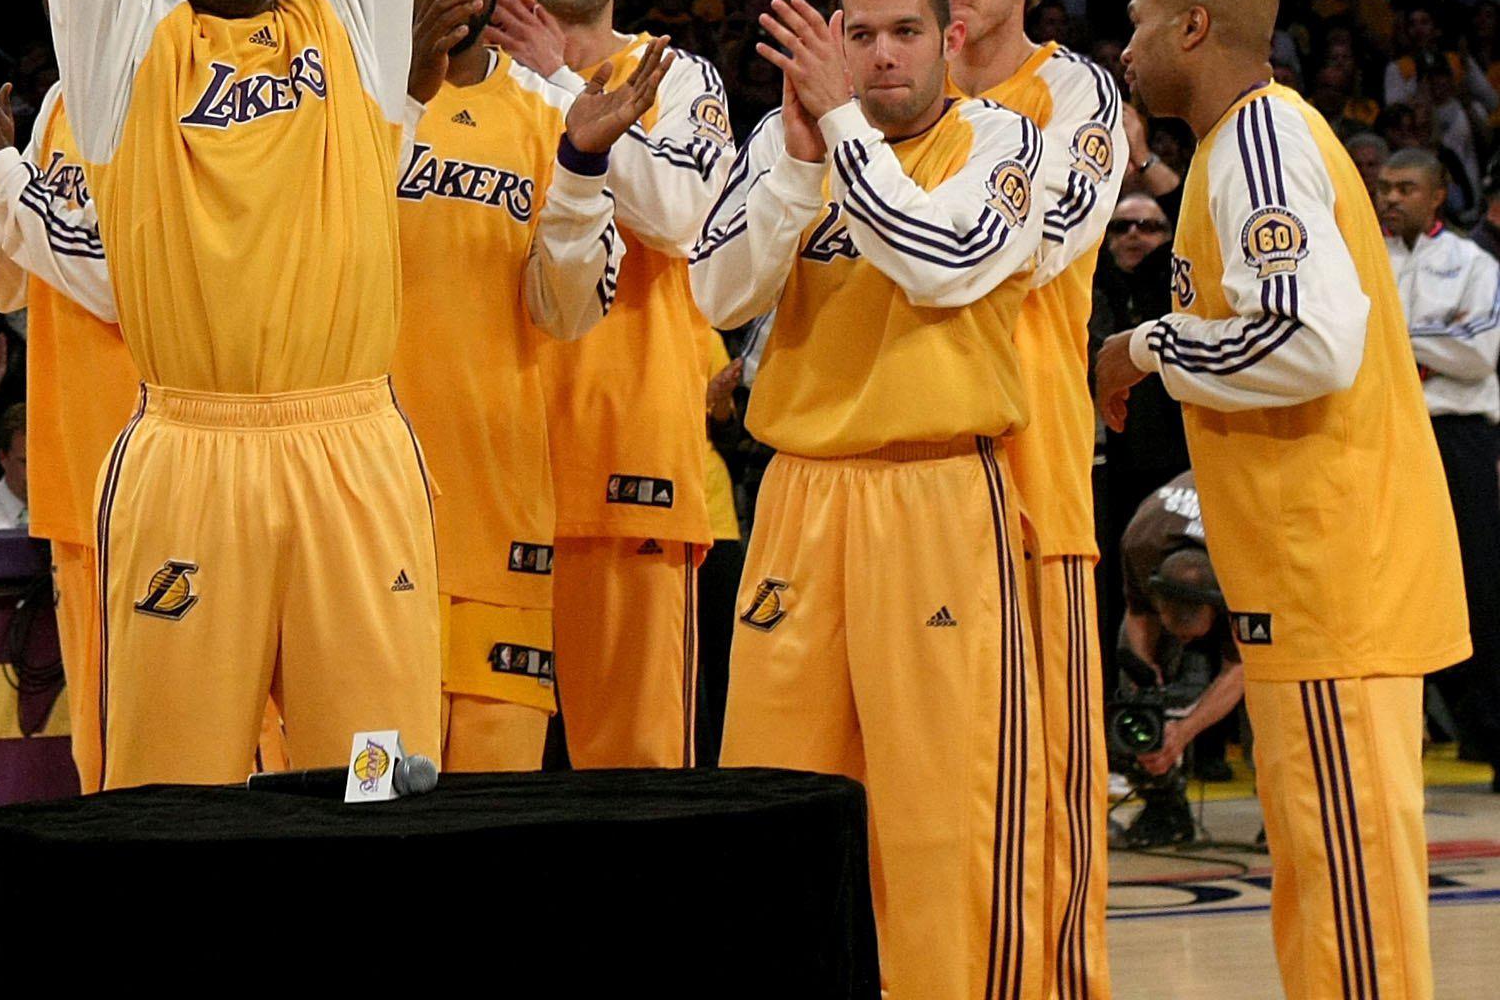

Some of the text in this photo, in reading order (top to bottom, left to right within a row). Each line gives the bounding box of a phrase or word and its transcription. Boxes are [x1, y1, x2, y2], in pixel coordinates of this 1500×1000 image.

[249, 35, 278, 48] adidas
[179, 48, 326, 128] LAKERS
[1084, 135, 1108, 167] 60
[396, 144, 535, 222] LAKERS
[1001, 173, 1026, 211] 60
[1256, 224, 1292, 253] 60
